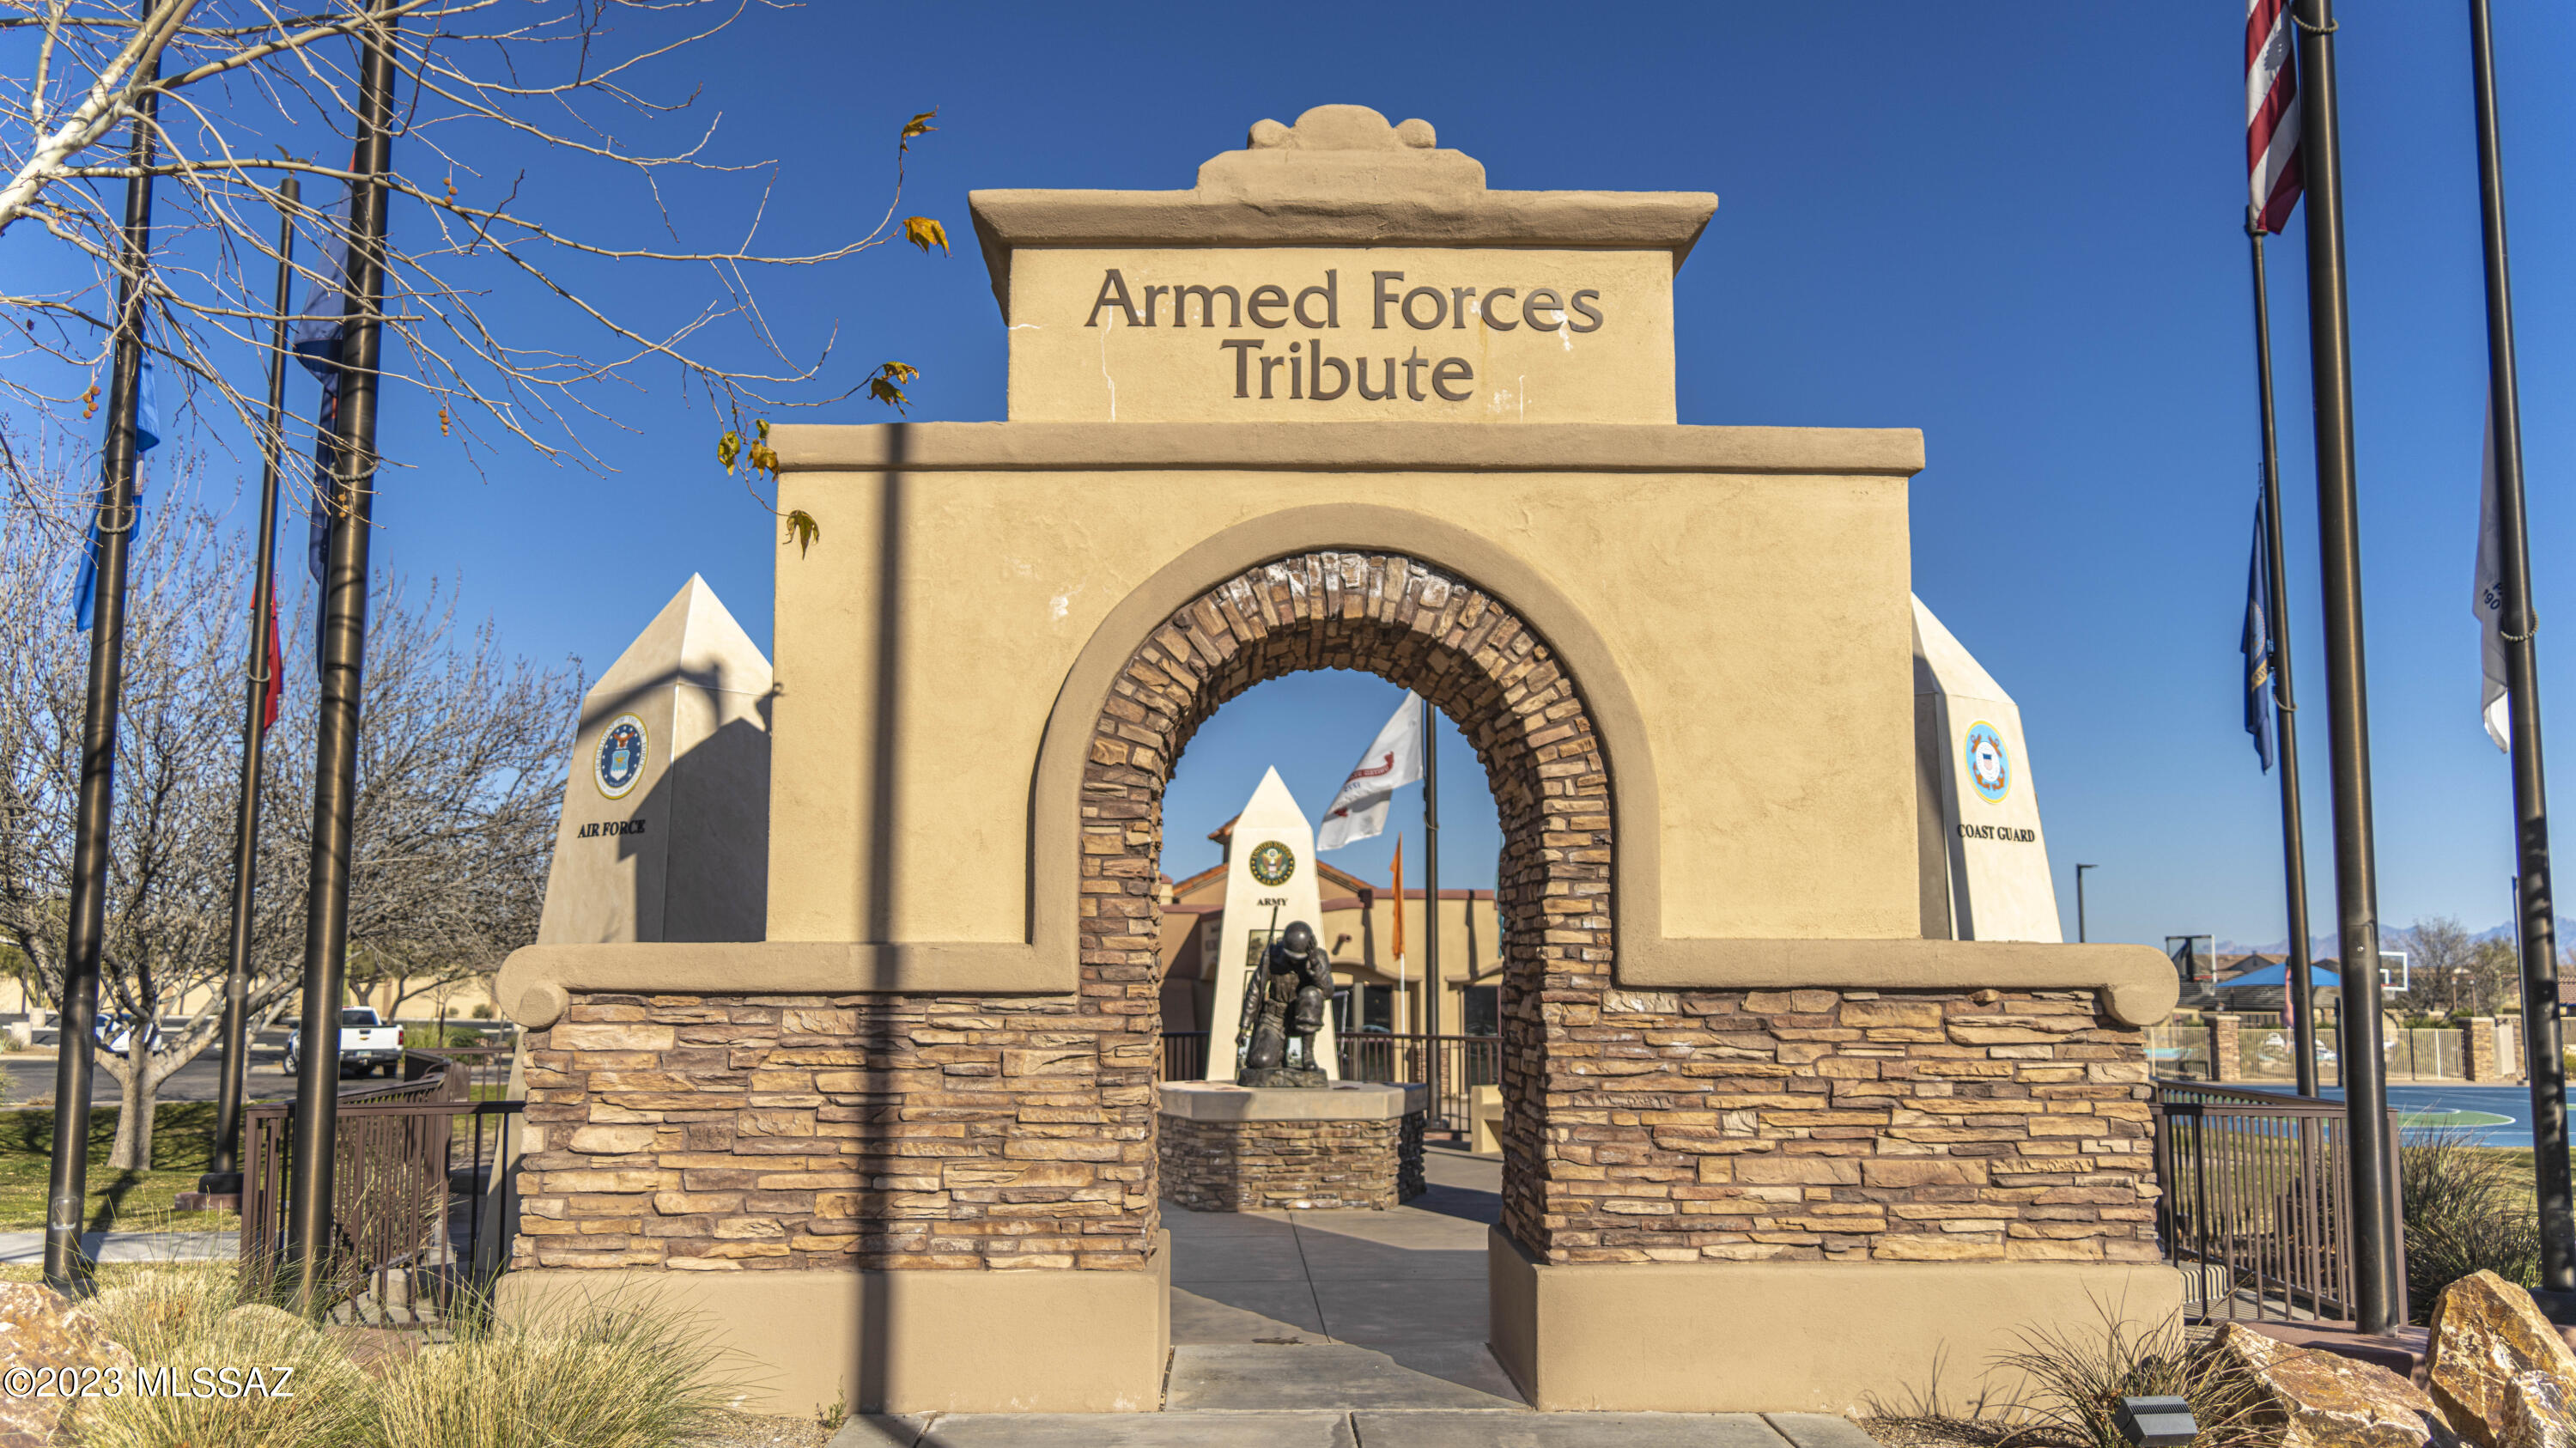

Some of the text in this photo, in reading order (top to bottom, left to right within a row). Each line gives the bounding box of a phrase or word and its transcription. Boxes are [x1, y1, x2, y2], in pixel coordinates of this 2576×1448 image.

[1084, 268, 1605, 332] Armed Forces
[1219, 338, 1474, 401] Tribute
[577, 819, 647, 839] AIR FORCE
[1957, 824, 2035, 843] COAST GUARD
[1257, 897, 1288, 907] ARMY
